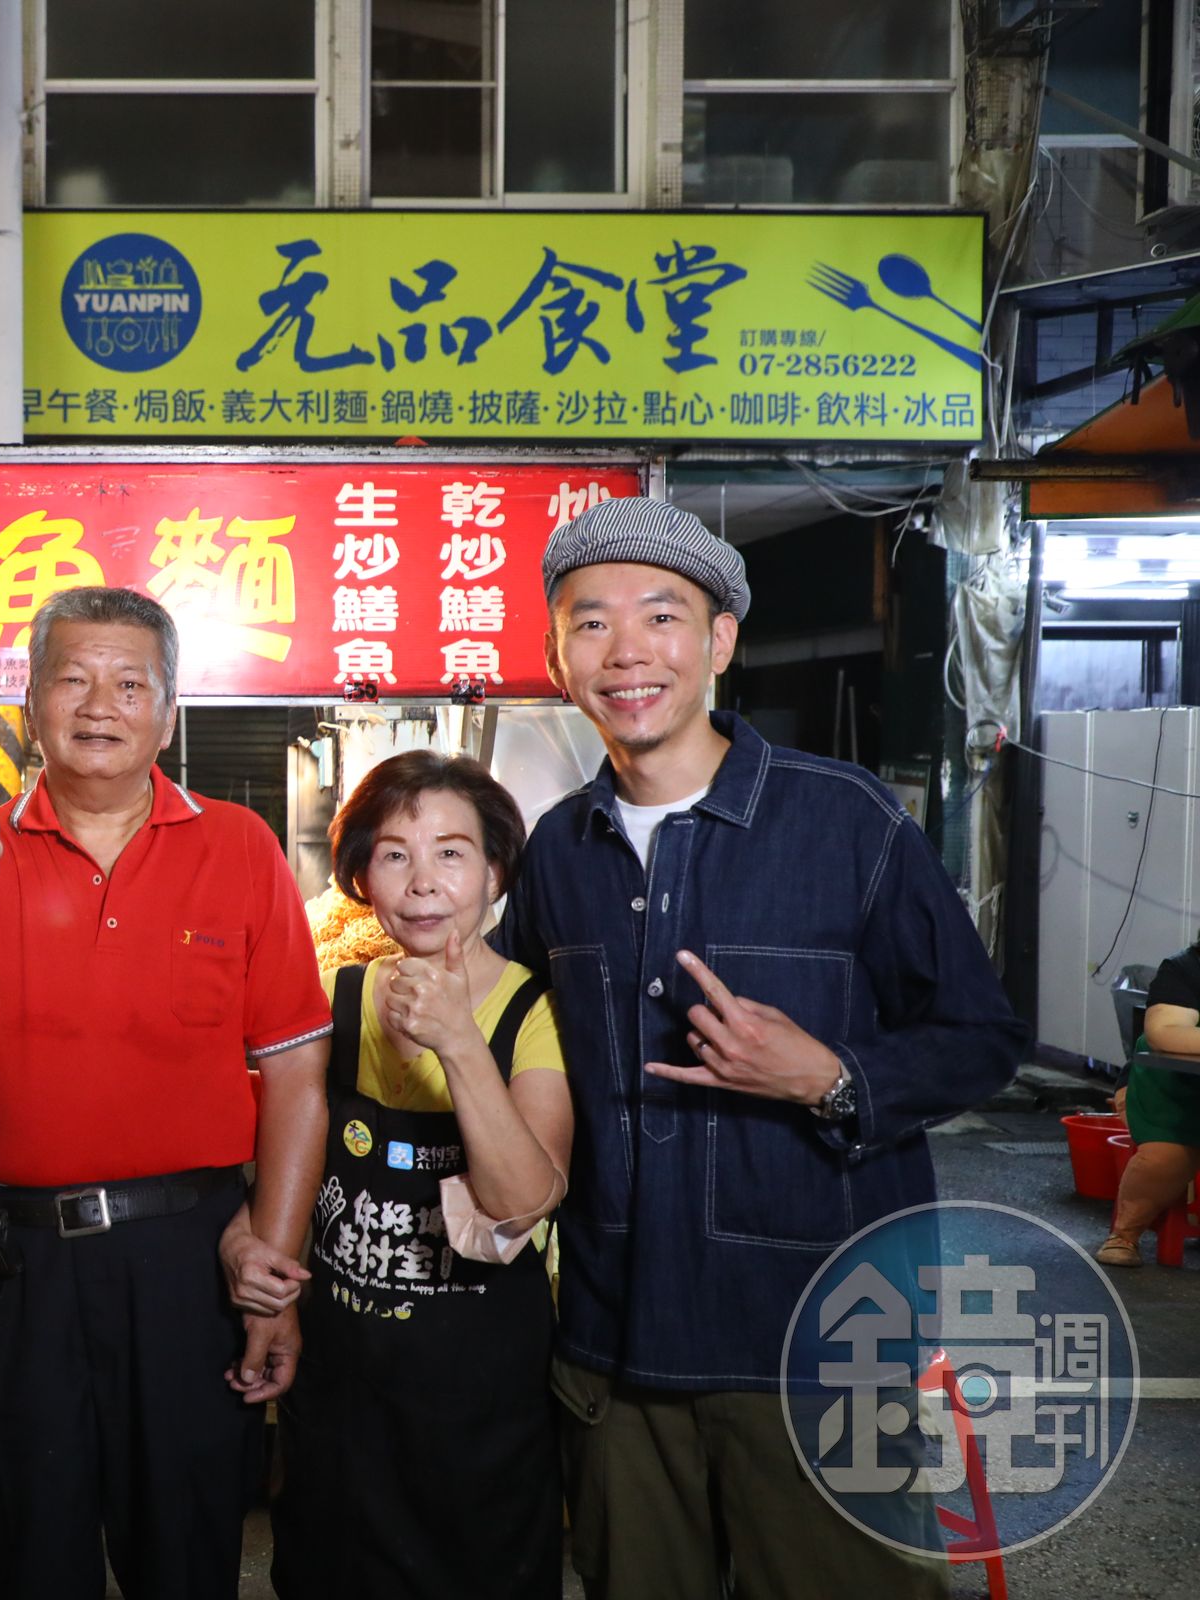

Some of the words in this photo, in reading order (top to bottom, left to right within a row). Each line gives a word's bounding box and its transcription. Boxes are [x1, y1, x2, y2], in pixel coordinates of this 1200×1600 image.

[74, 294, 190, 313] YUANPIN
[236, 238, 747, 375] 元品食堂
[739, 353, 917, 377] 07-2856222
[332, 481, 400, 685] 生炒鱔魚
[439, 481, 506, 685] 乾炒鱔魚
[410, 1282, 434, 1295] happy
[437, 1282, 448, 1293] all
